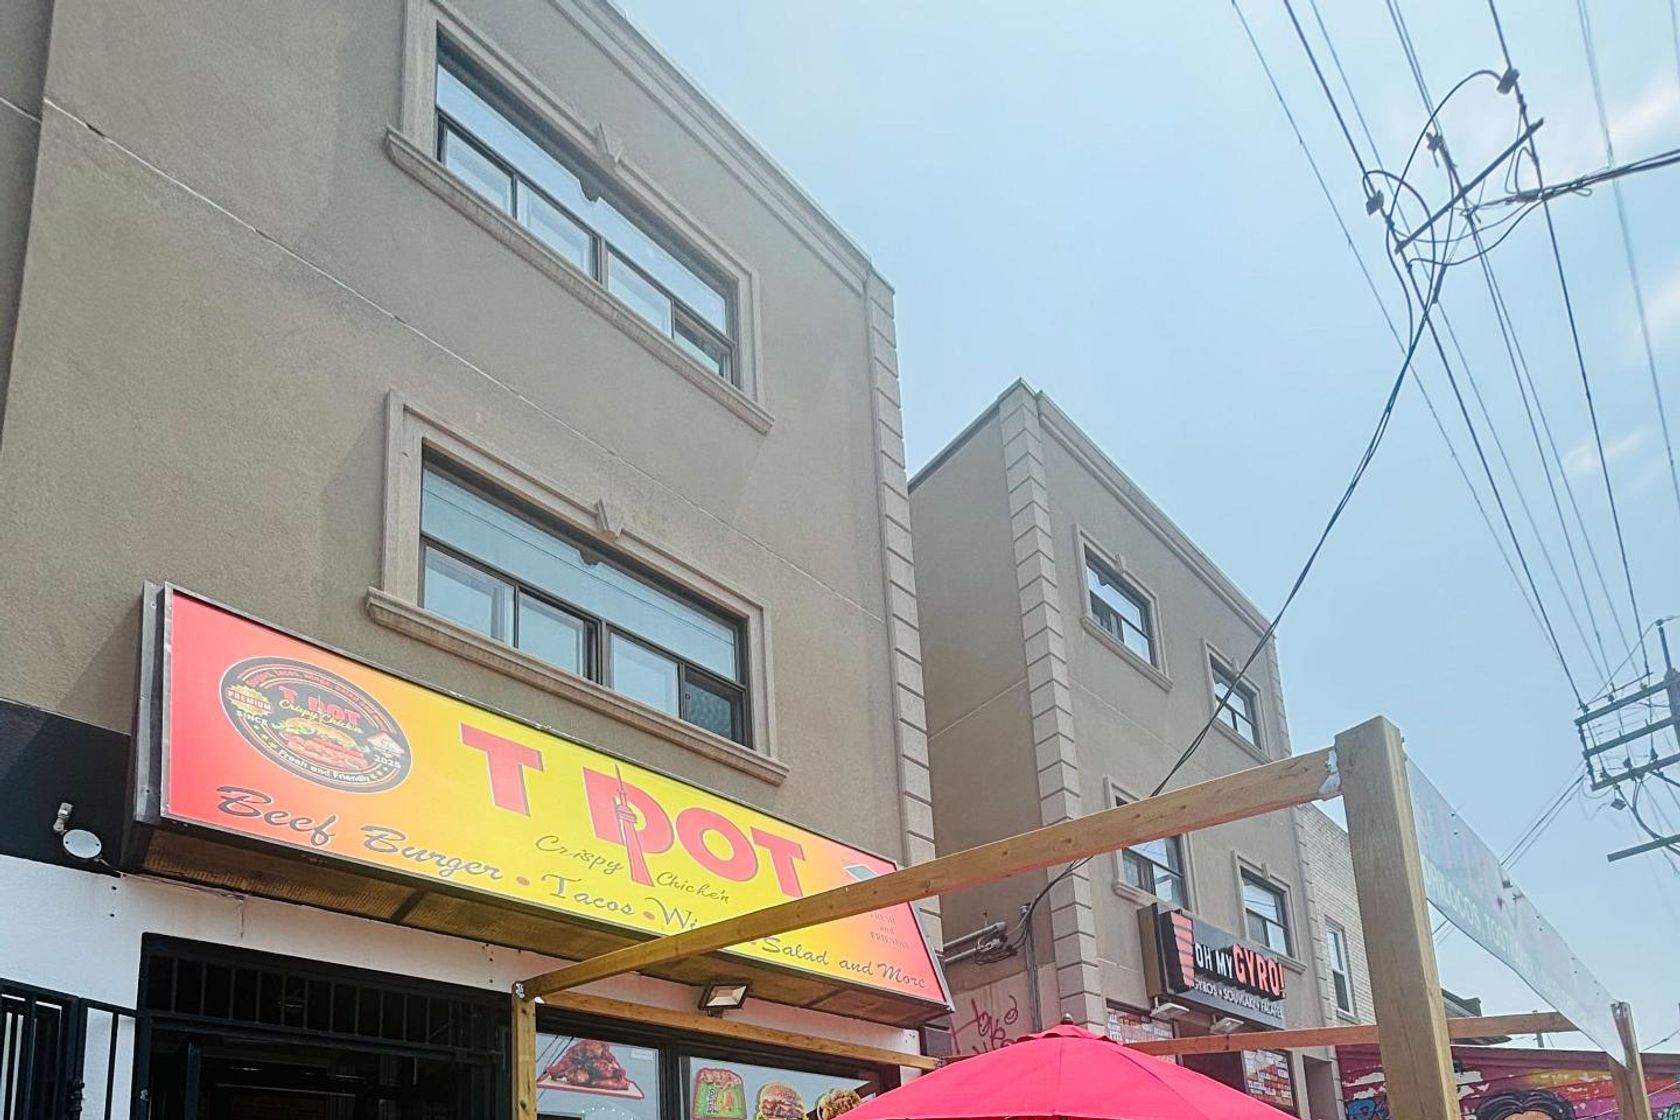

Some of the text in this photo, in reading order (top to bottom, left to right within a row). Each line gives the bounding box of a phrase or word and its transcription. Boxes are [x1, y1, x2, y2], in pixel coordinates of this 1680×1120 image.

[227, 689, 272, 710] PREMIUM
[279, 699, 319, 722] Crispy
[236, 710, 269, 728] SINCE
[277, 750, 371, 784] Fresh and Friendly
[460, 722, 806, 898] T DOT
[535, 835, 623, 875] Crispy
[216, 785, 338, 847] Beef
[360, 824, 504, 879] Burger
[540, 873, 636, 916] Tacos
[762, 936, 830, 966] Salad
[839, 957, 874, 976] and
[876, 962, 927, 989] More
[1195, 942, 1287, 999] OH MY GYRO!
